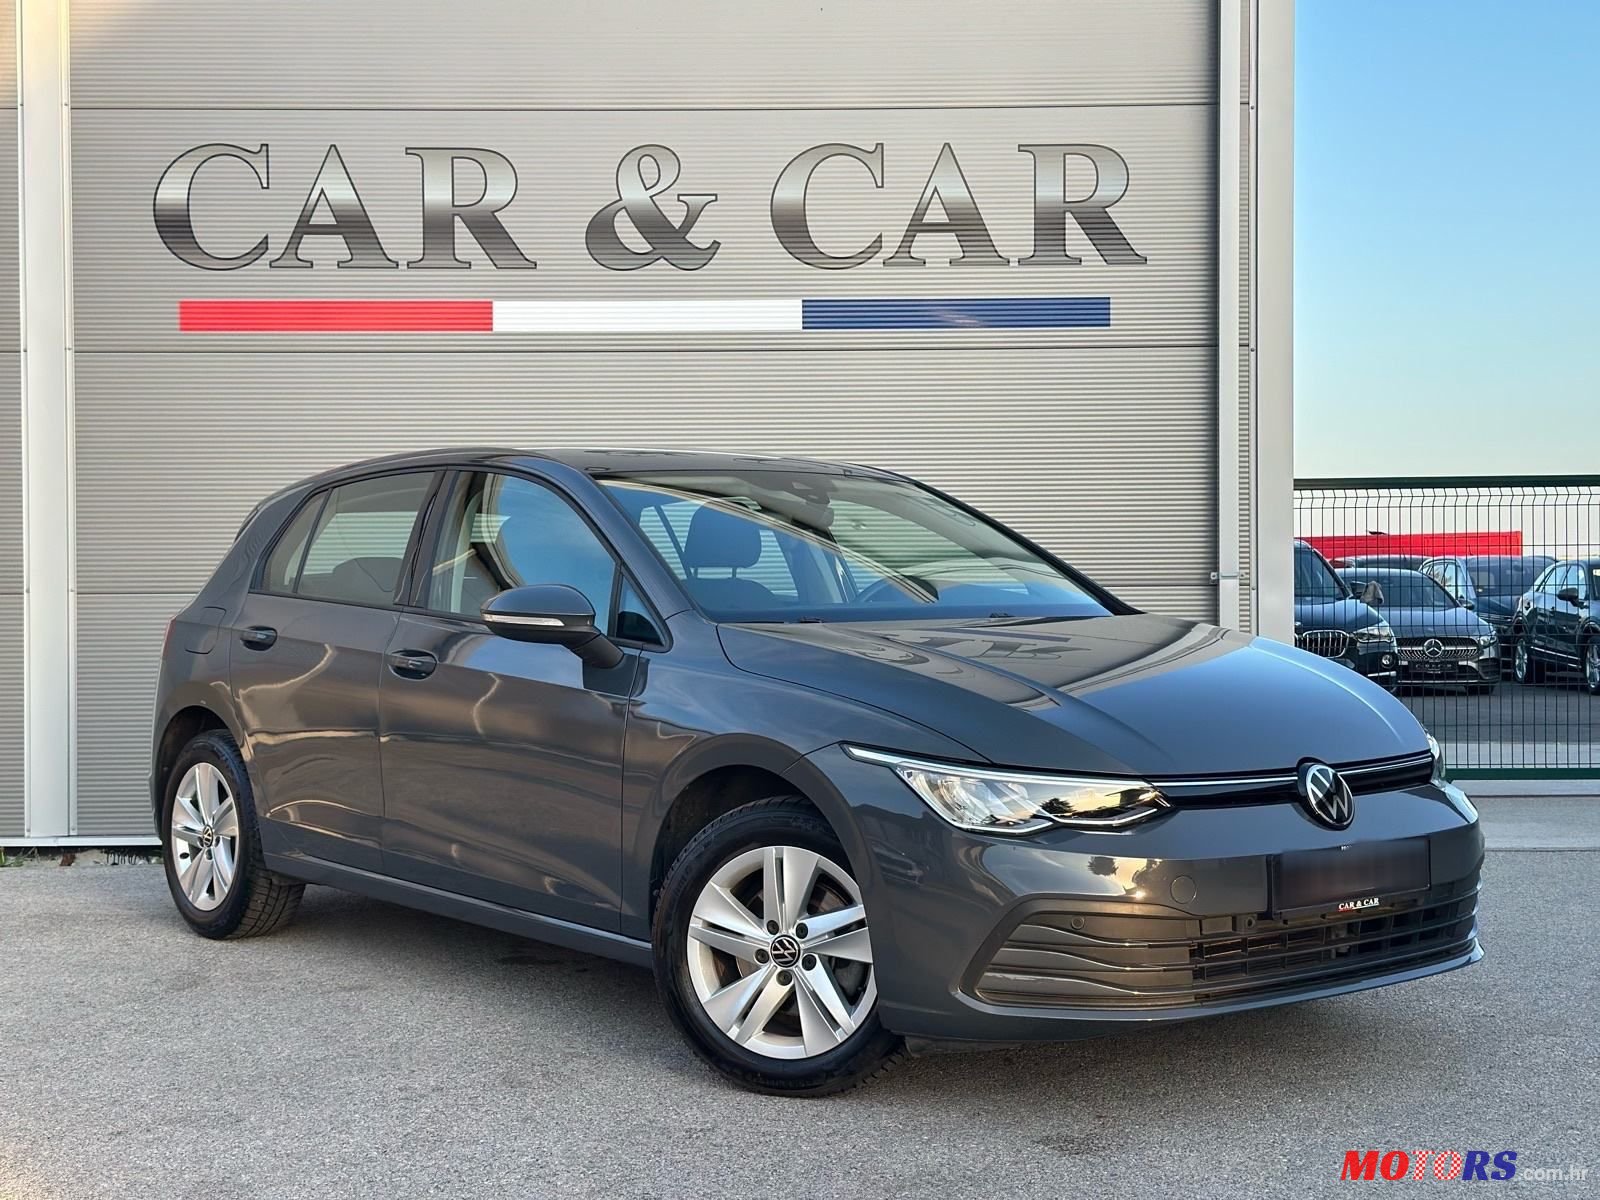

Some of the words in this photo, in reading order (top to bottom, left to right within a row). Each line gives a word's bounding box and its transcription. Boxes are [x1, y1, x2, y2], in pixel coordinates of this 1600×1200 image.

[153, 143, 537, 271] CAR
[585, 144, 721, 271] &
[770, 142, 1148, 270] CAR
[1338, 902, 1355, 910] CAR
[1363, 897, 1380, 906] CAR
